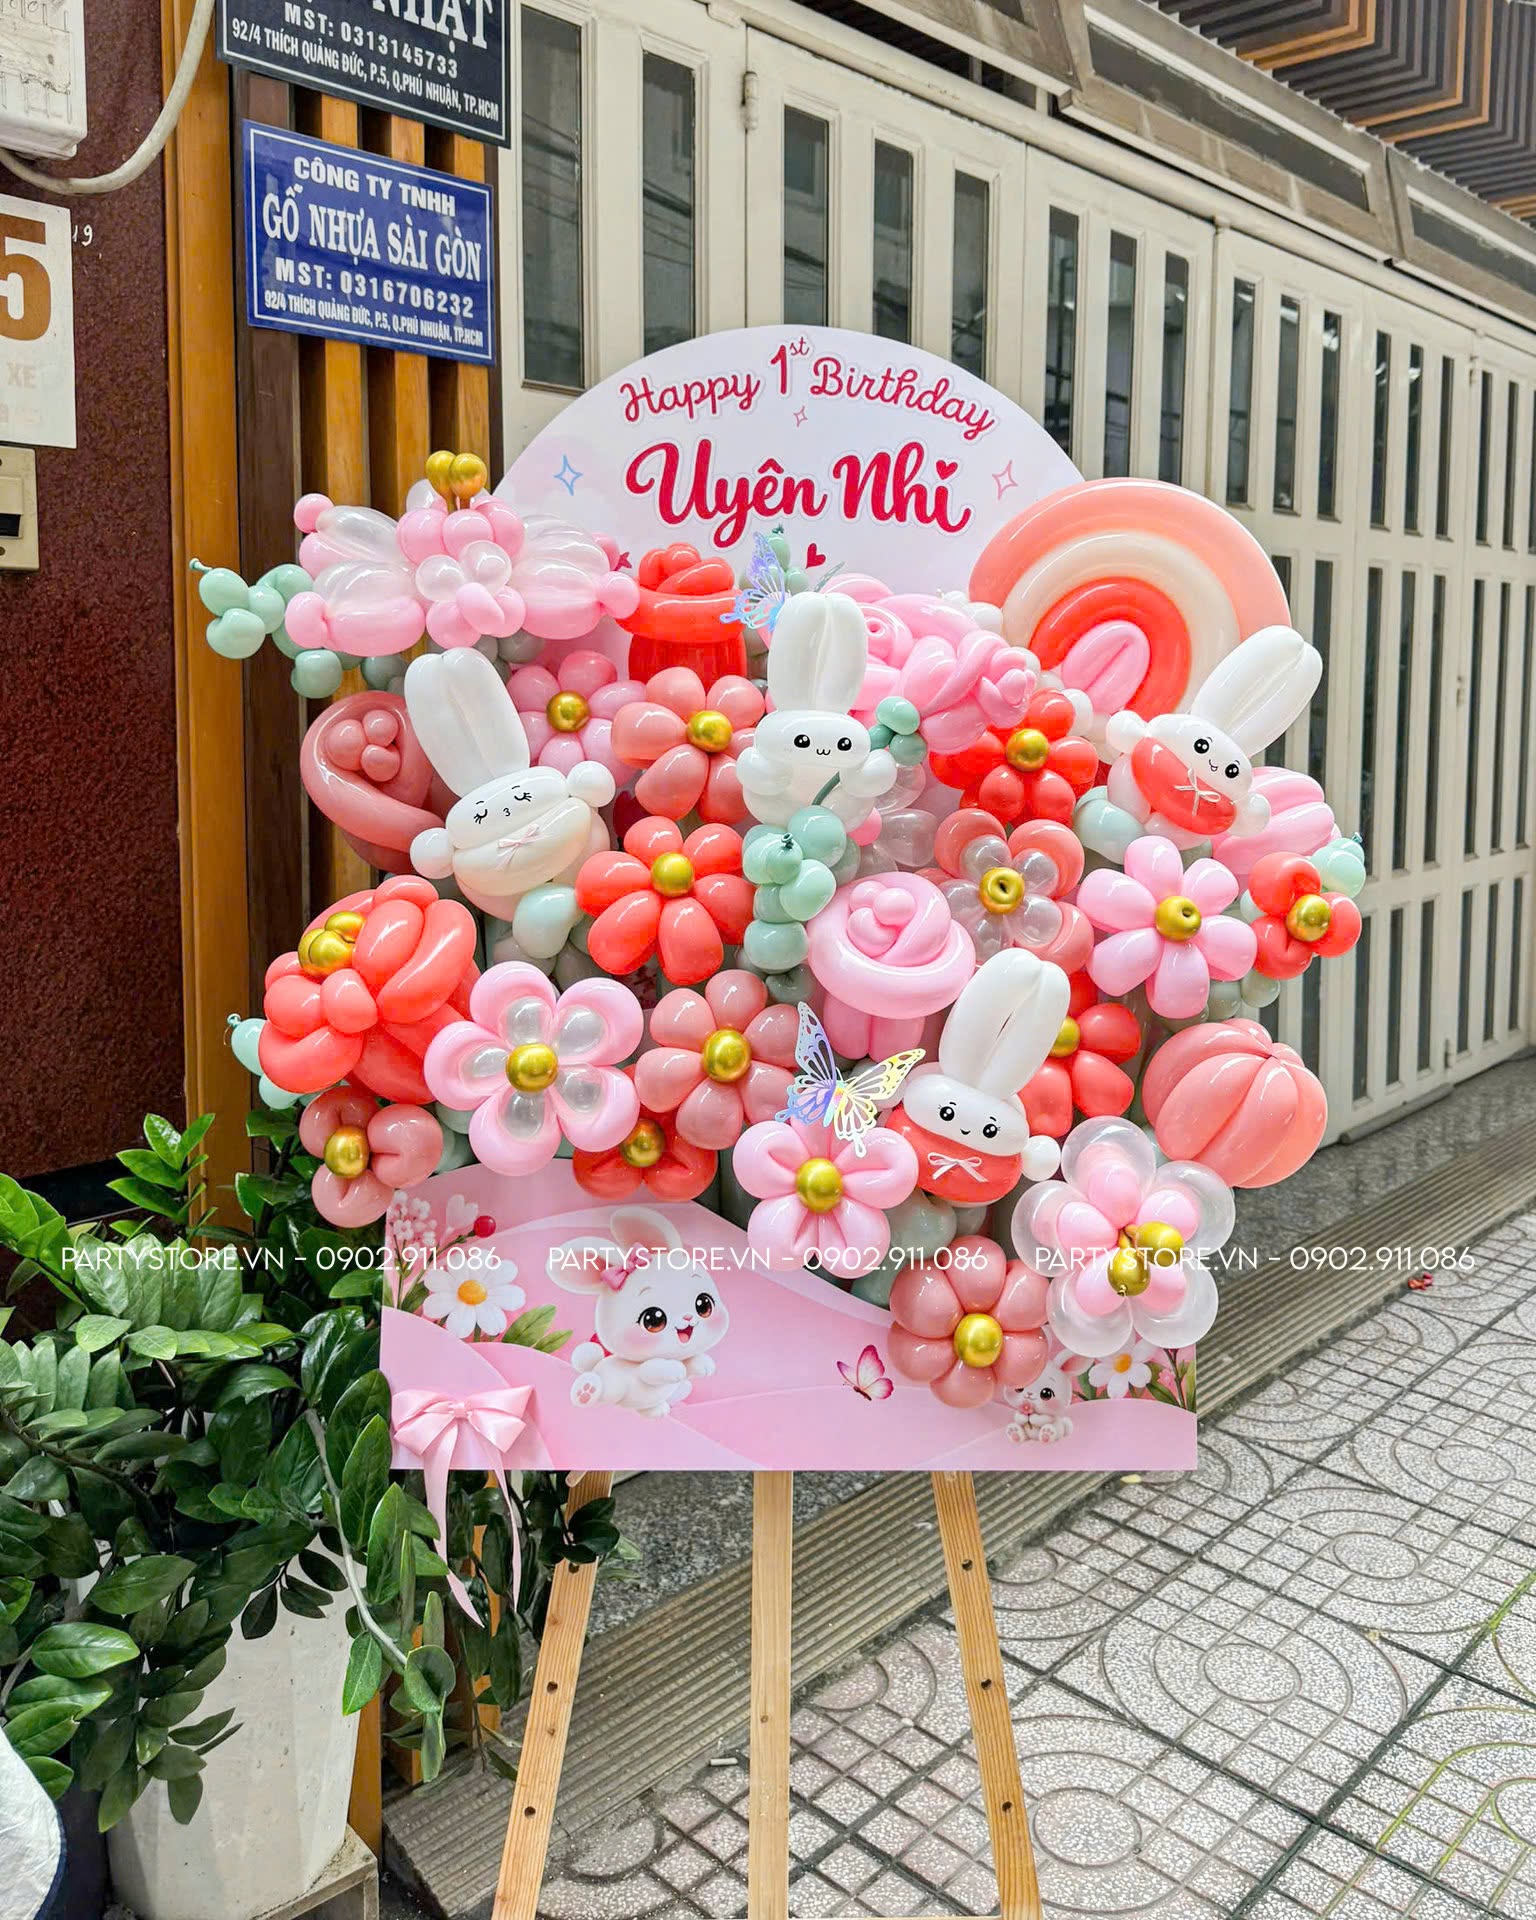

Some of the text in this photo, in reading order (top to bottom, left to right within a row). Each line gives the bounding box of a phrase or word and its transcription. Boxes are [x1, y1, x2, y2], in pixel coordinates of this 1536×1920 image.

[232, 17, 499, 122] 92/4 THÍCH QUẢNG ĐỨC, P.5, Q.PHÚ NHUẬN, TP.HCM
[284, 2, 458, 79] MST: 0313145733
[293, 156, 456, 217] CÔNG TY TNHH
[262, 183, 482, 282] GỖ NHỰA SÀI GÒN
[264, 289, 287, 311] 92/4
[287, 293, 316, 316] THÍCH
[317, 297, 350, 322] QUẢNG
[374, 310, 391, 332] P.5,
[392, 314, 418, 335] Q.PHÚ
[453, 325, 484, 348] TP.HCM
[275, 256, 474, 319] MST: 0316706232
[620, 371, 761, 422] Happy
[809, 357, 995, 441] Birthday
[625, 439, 971, 549] Uyên Nhi
